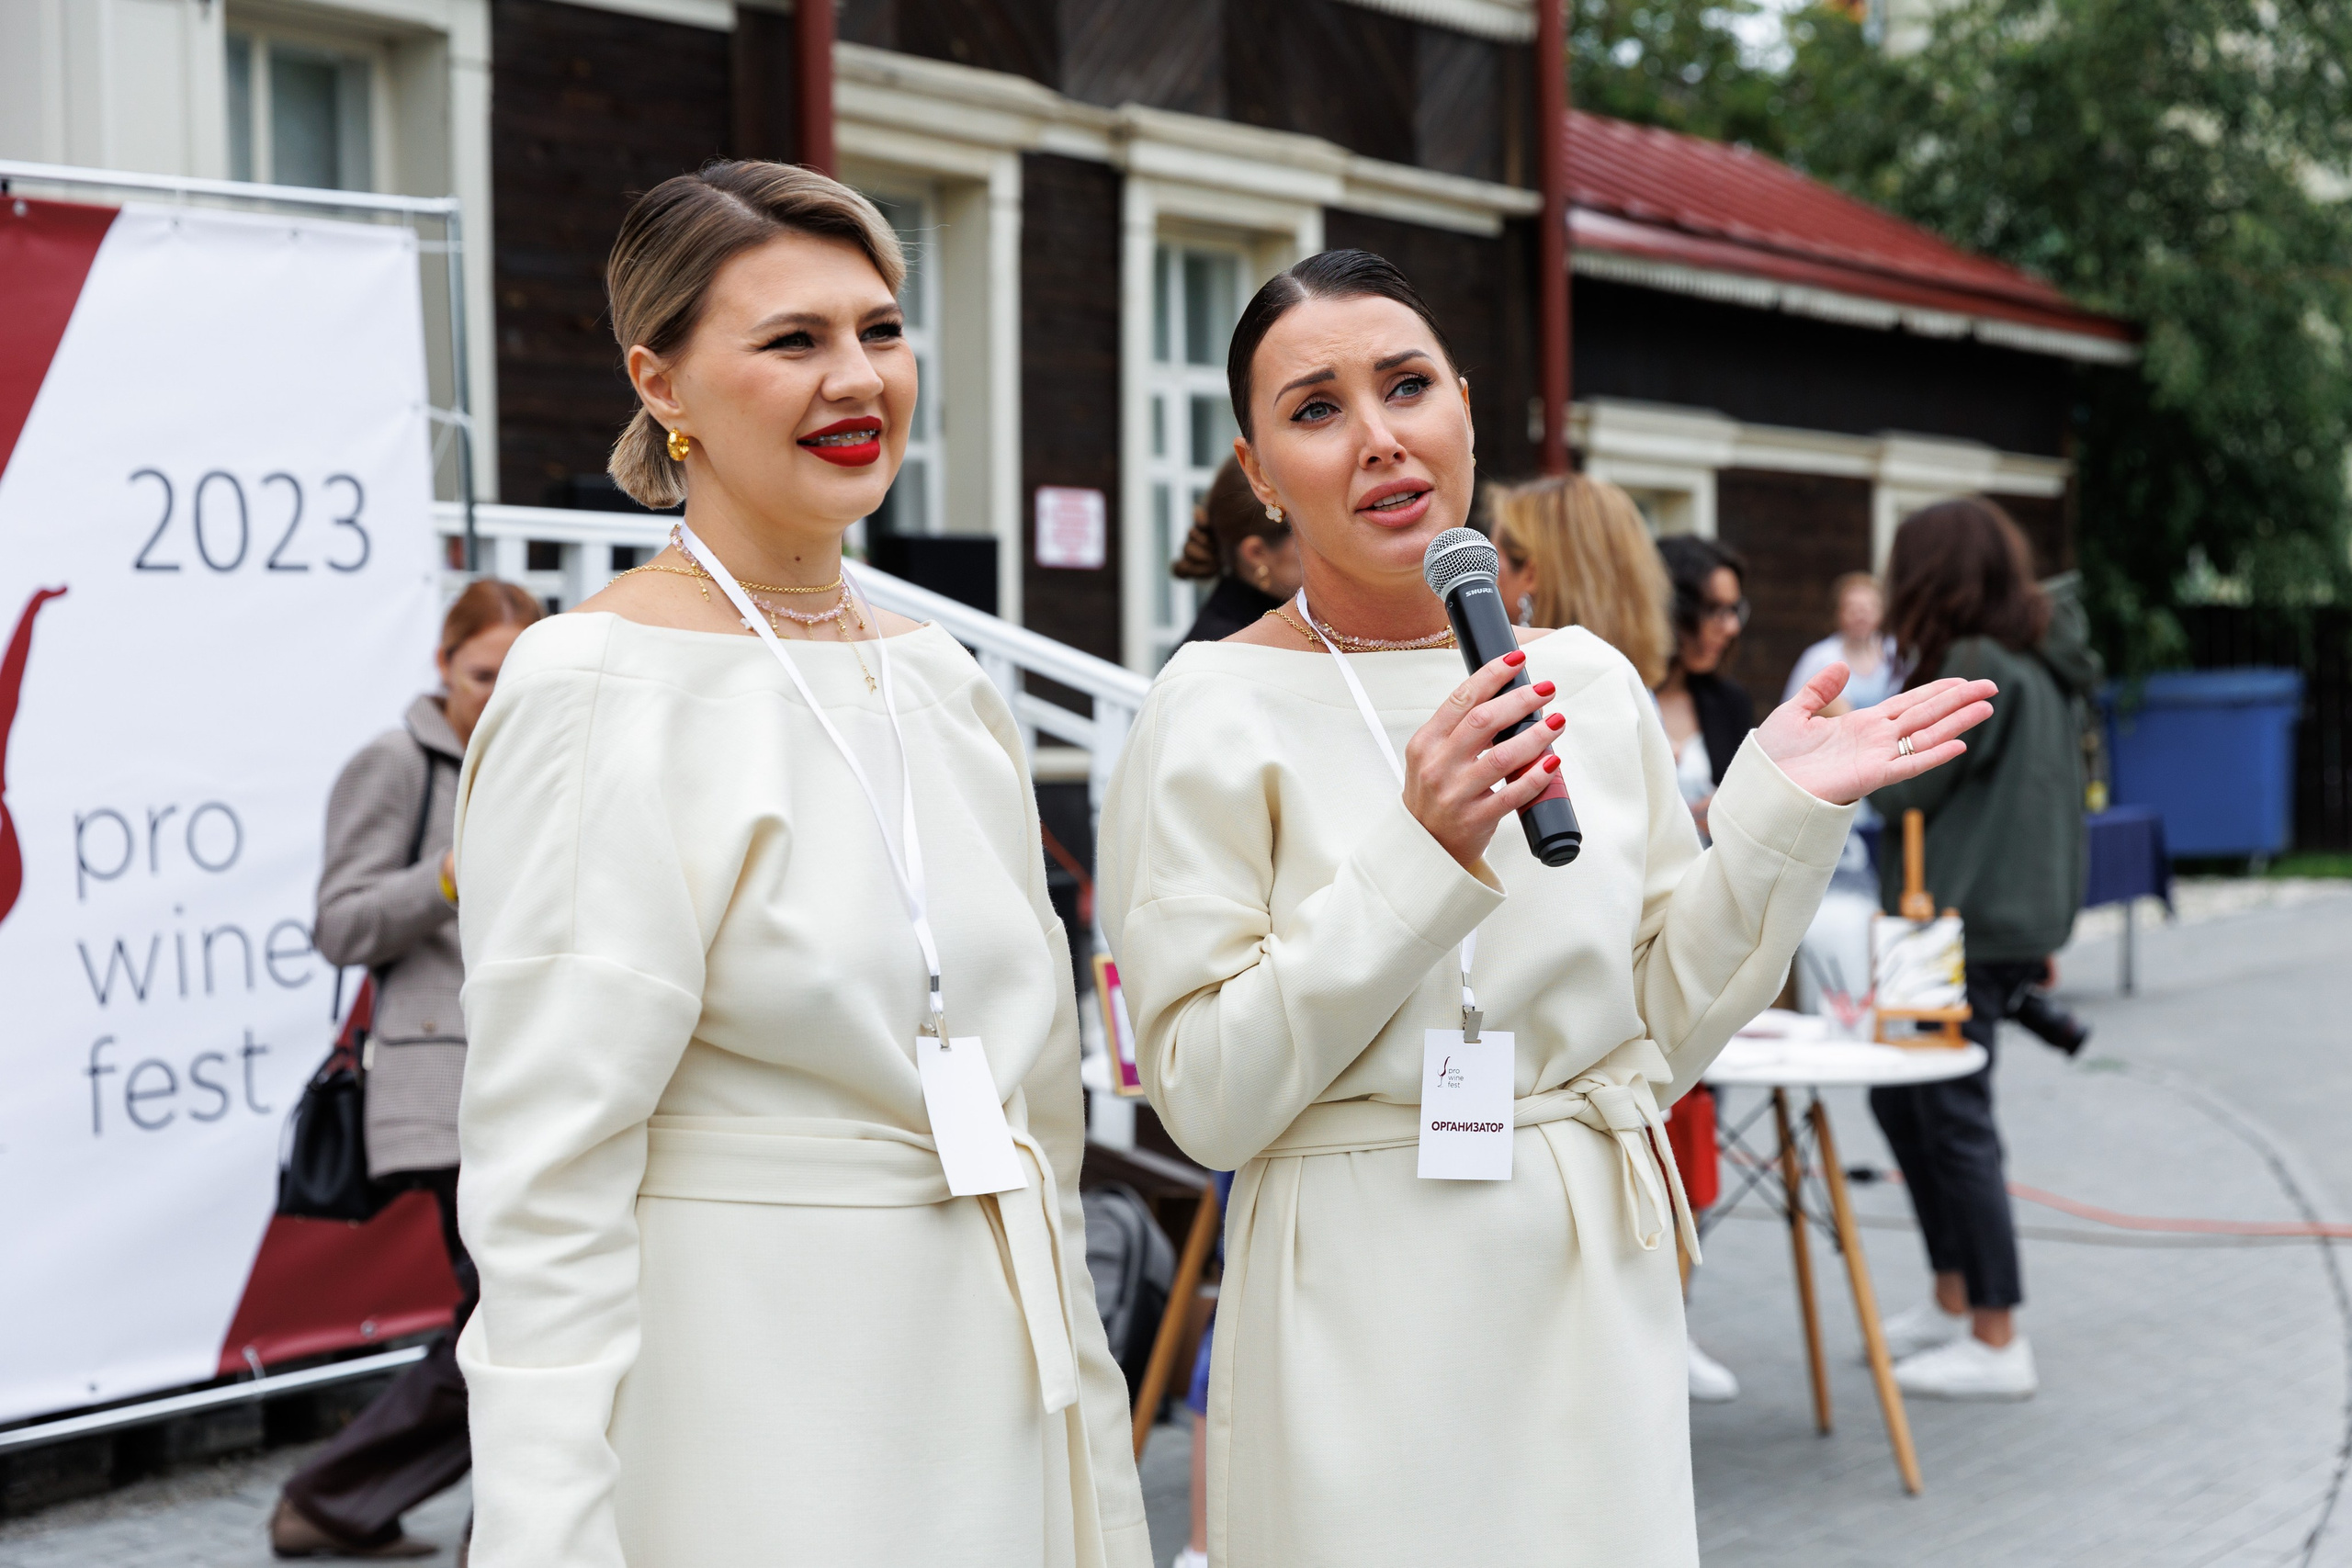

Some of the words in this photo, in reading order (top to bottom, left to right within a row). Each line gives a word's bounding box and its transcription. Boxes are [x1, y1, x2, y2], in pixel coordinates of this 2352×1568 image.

[128, 467, 372, 575] 2023
[1465, 588, 1493, 597] SHURE
[73, 801, 244, 901] pro
[76, 905, 318, 1009] wine
[84, 1029, 272, 1136] fest
[1431, 1121, 1504, 1133] ОРГАНИЗАТОР
